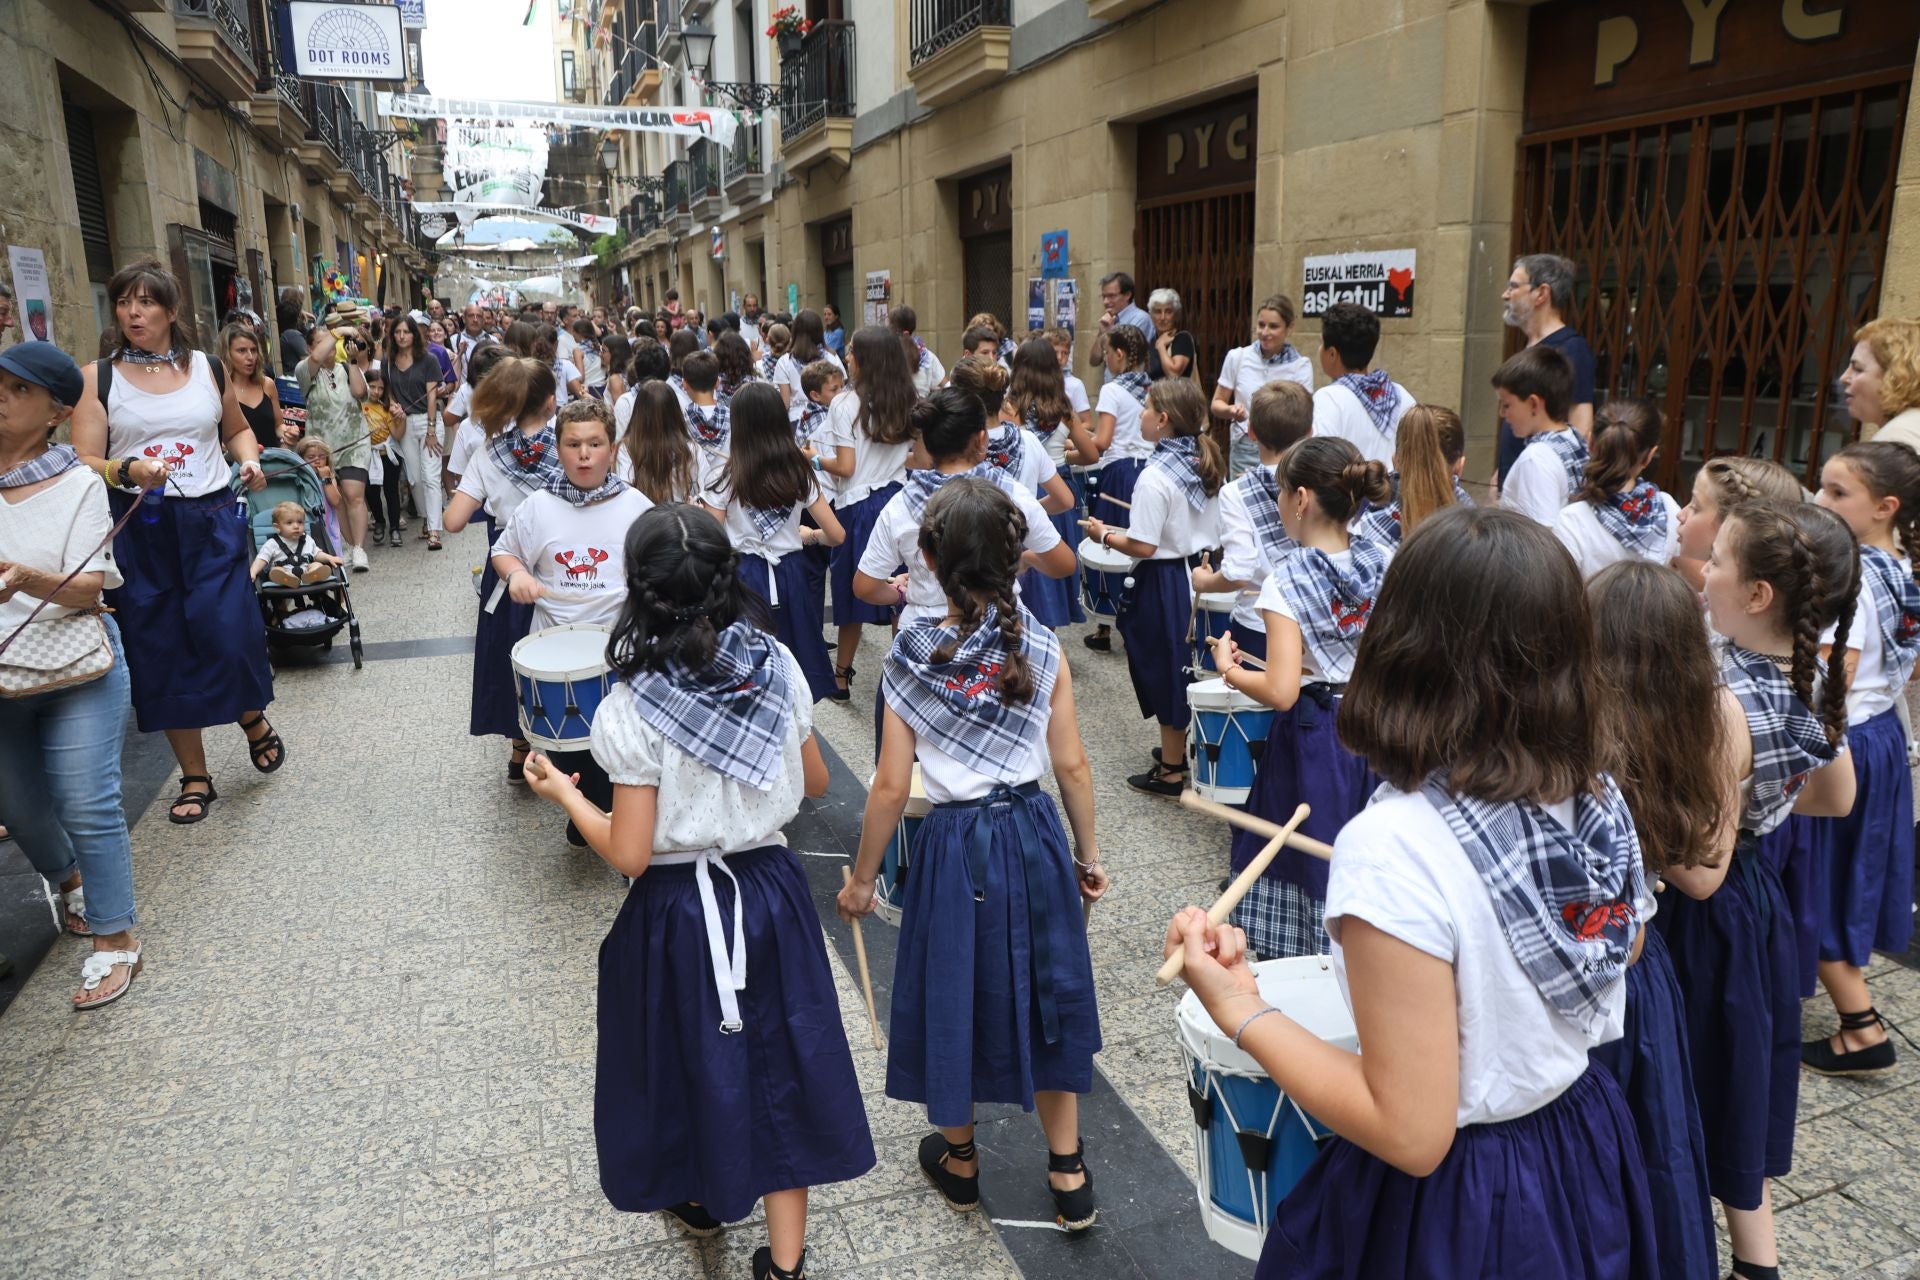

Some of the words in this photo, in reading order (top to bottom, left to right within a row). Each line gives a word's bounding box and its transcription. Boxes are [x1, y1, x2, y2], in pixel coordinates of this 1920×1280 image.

[308, 49, 335, 63] DOT
[342, 50, 390, 65] ROOMS
[1167, 114, 1248, 175] PYC
[1305, 266, 1343, 282] EUSKAL
[1345, 263, 1385, 280] HERRIA
[1303, 282, 1386, 314] askatu!
